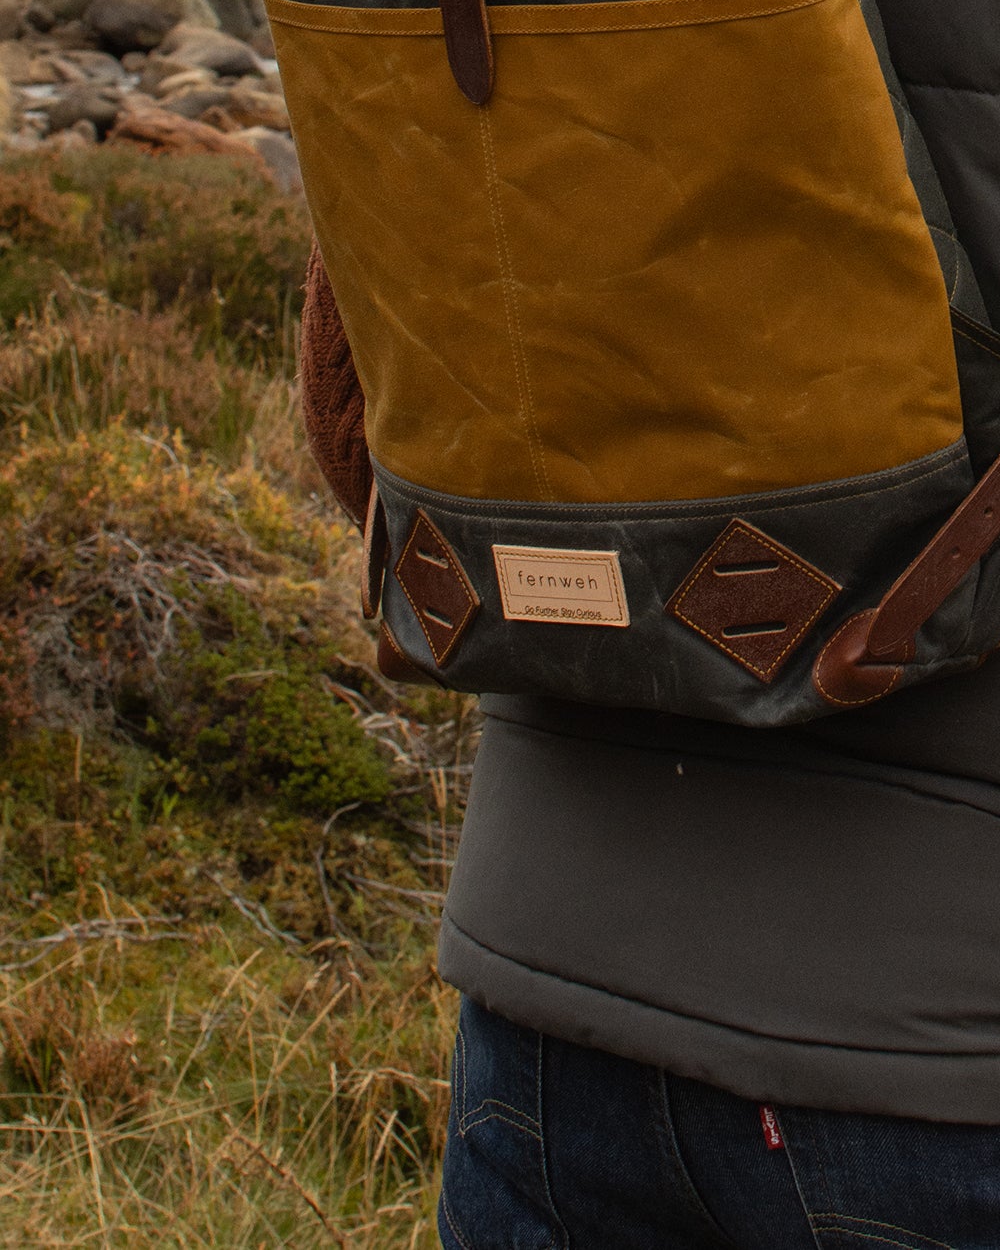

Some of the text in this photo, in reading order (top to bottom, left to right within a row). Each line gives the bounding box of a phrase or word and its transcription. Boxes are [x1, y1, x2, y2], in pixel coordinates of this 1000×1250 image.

[518, 570, 598, 590] fernweh
[525, 605, 602, 618] Go Further Stay Curious
